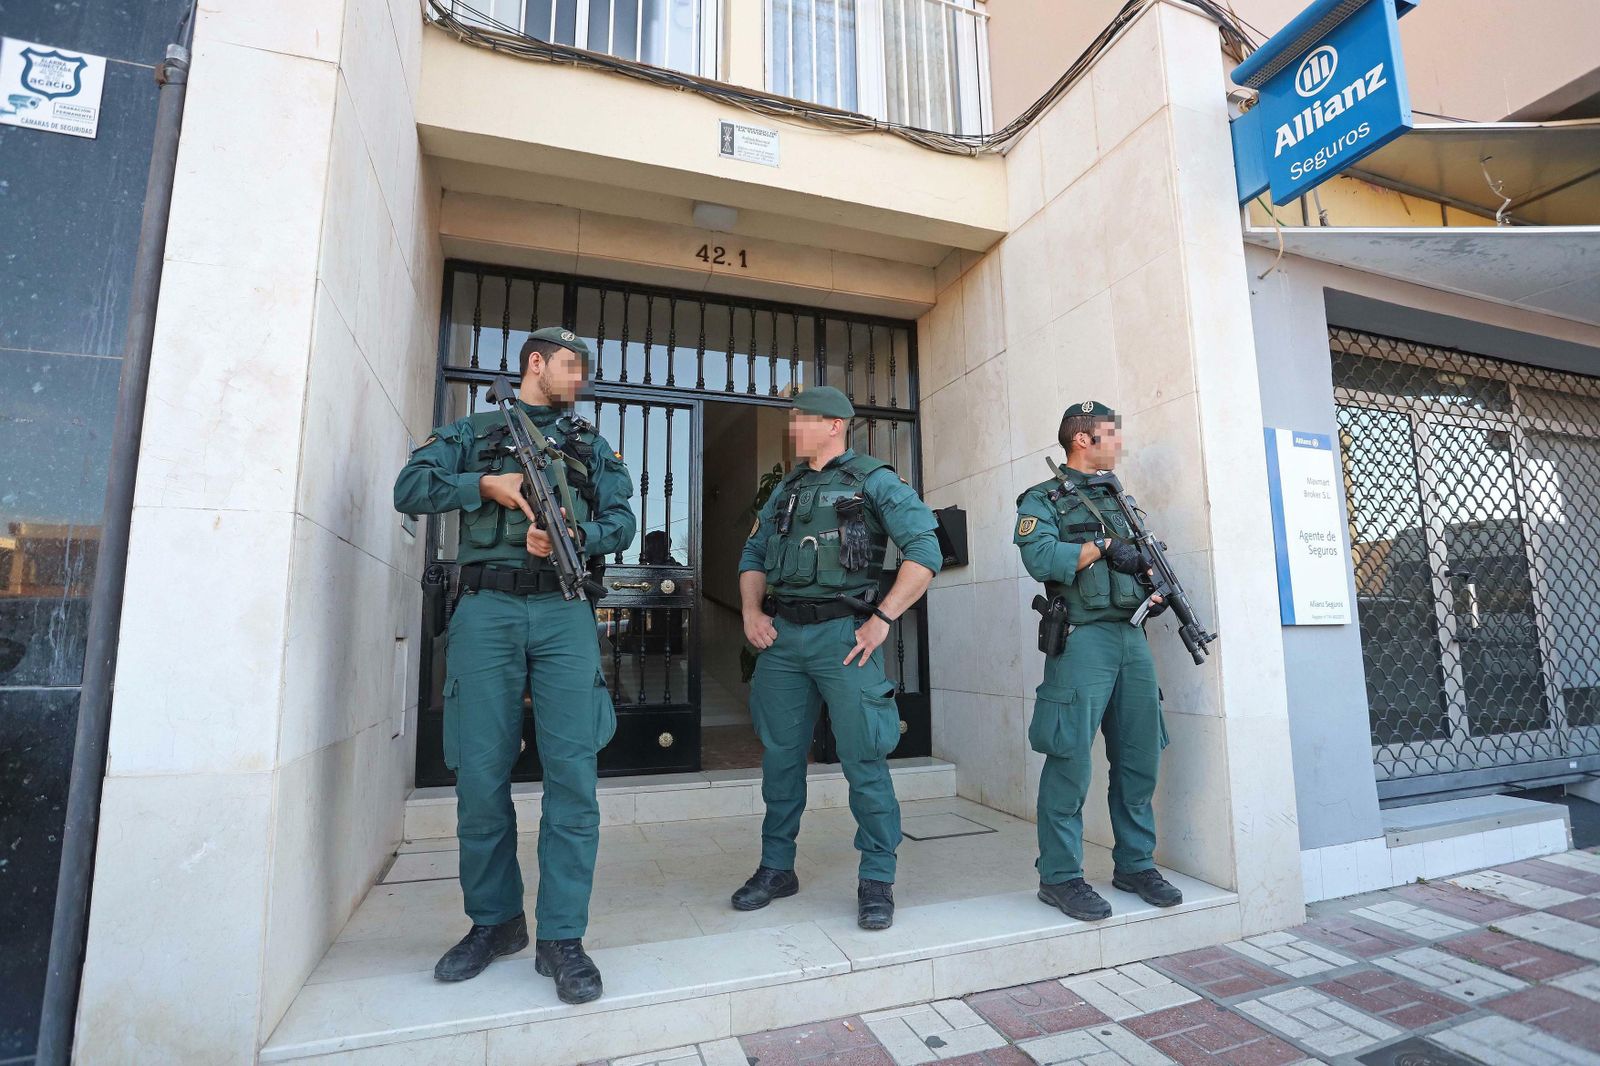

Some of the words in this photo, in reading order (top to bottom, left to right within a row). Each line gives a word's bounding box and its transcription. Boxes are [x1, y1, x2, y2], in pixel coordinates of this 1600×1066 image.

[1274, 62, 1387, 158] Allianz
[51, 121, 58, 129] DE
[60, 124, 93, 135] SEGURIDAD
[1290, 121, 1371, 180] Seguros
[695, 244, 748, 268] 42.1
[1303, 489, 1321, 499] Broker
[1299, 530, 1325, 543] Agente
[1326, 531, 1336, 542] de
[1308, 545, 1338, 558] Seguros
[1325, 601, 1343, 609] Seguros
